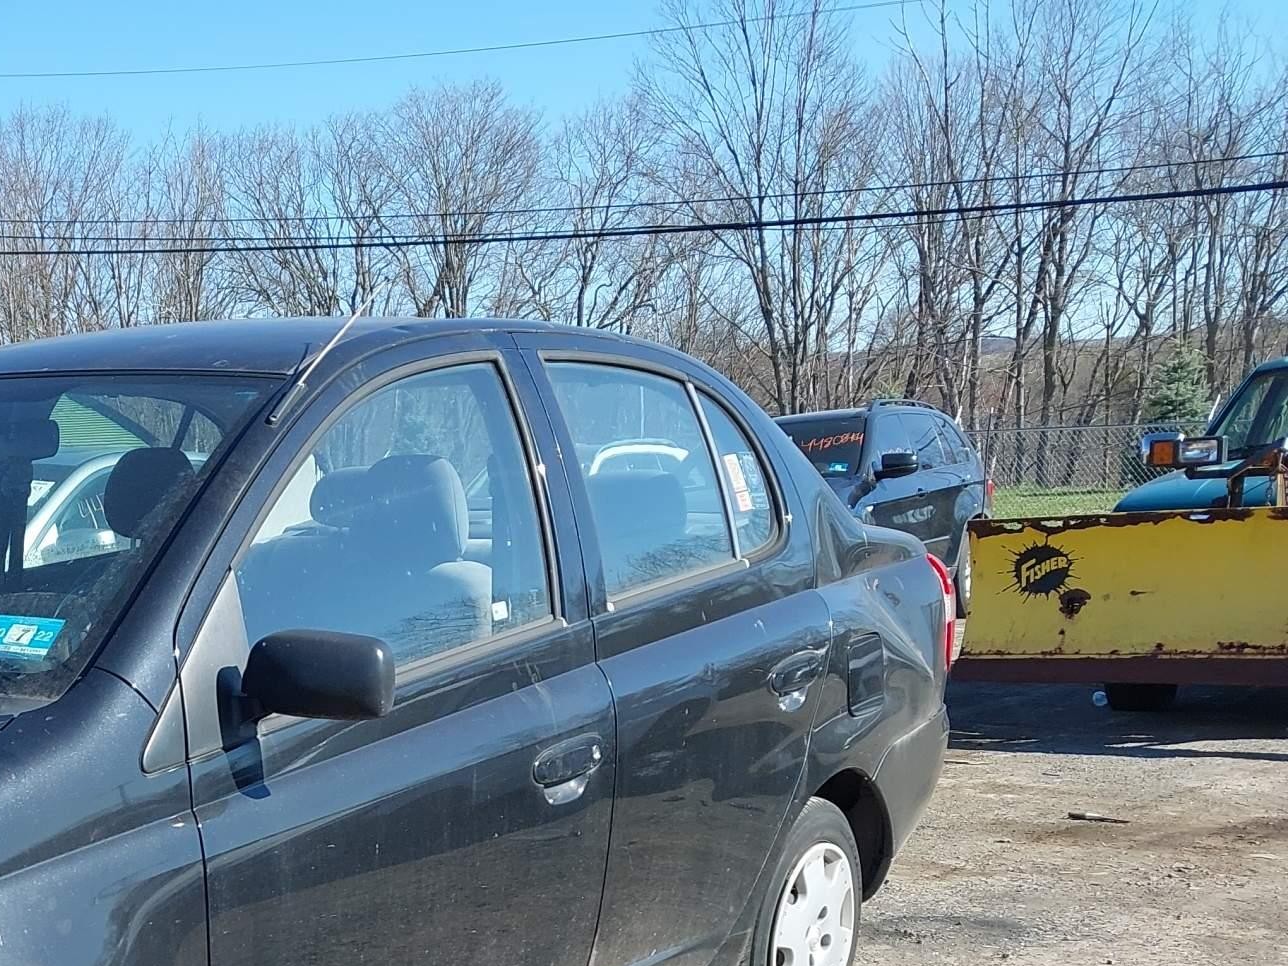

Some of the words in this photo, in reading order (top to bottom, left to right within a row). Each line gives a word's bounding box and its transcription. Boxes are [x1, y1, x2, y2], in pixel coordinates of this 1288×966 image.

[1021, 557, 1069, 588] FISHER
[15, 629, 31, 642] 7
[33, 630, 53, 642] 22
